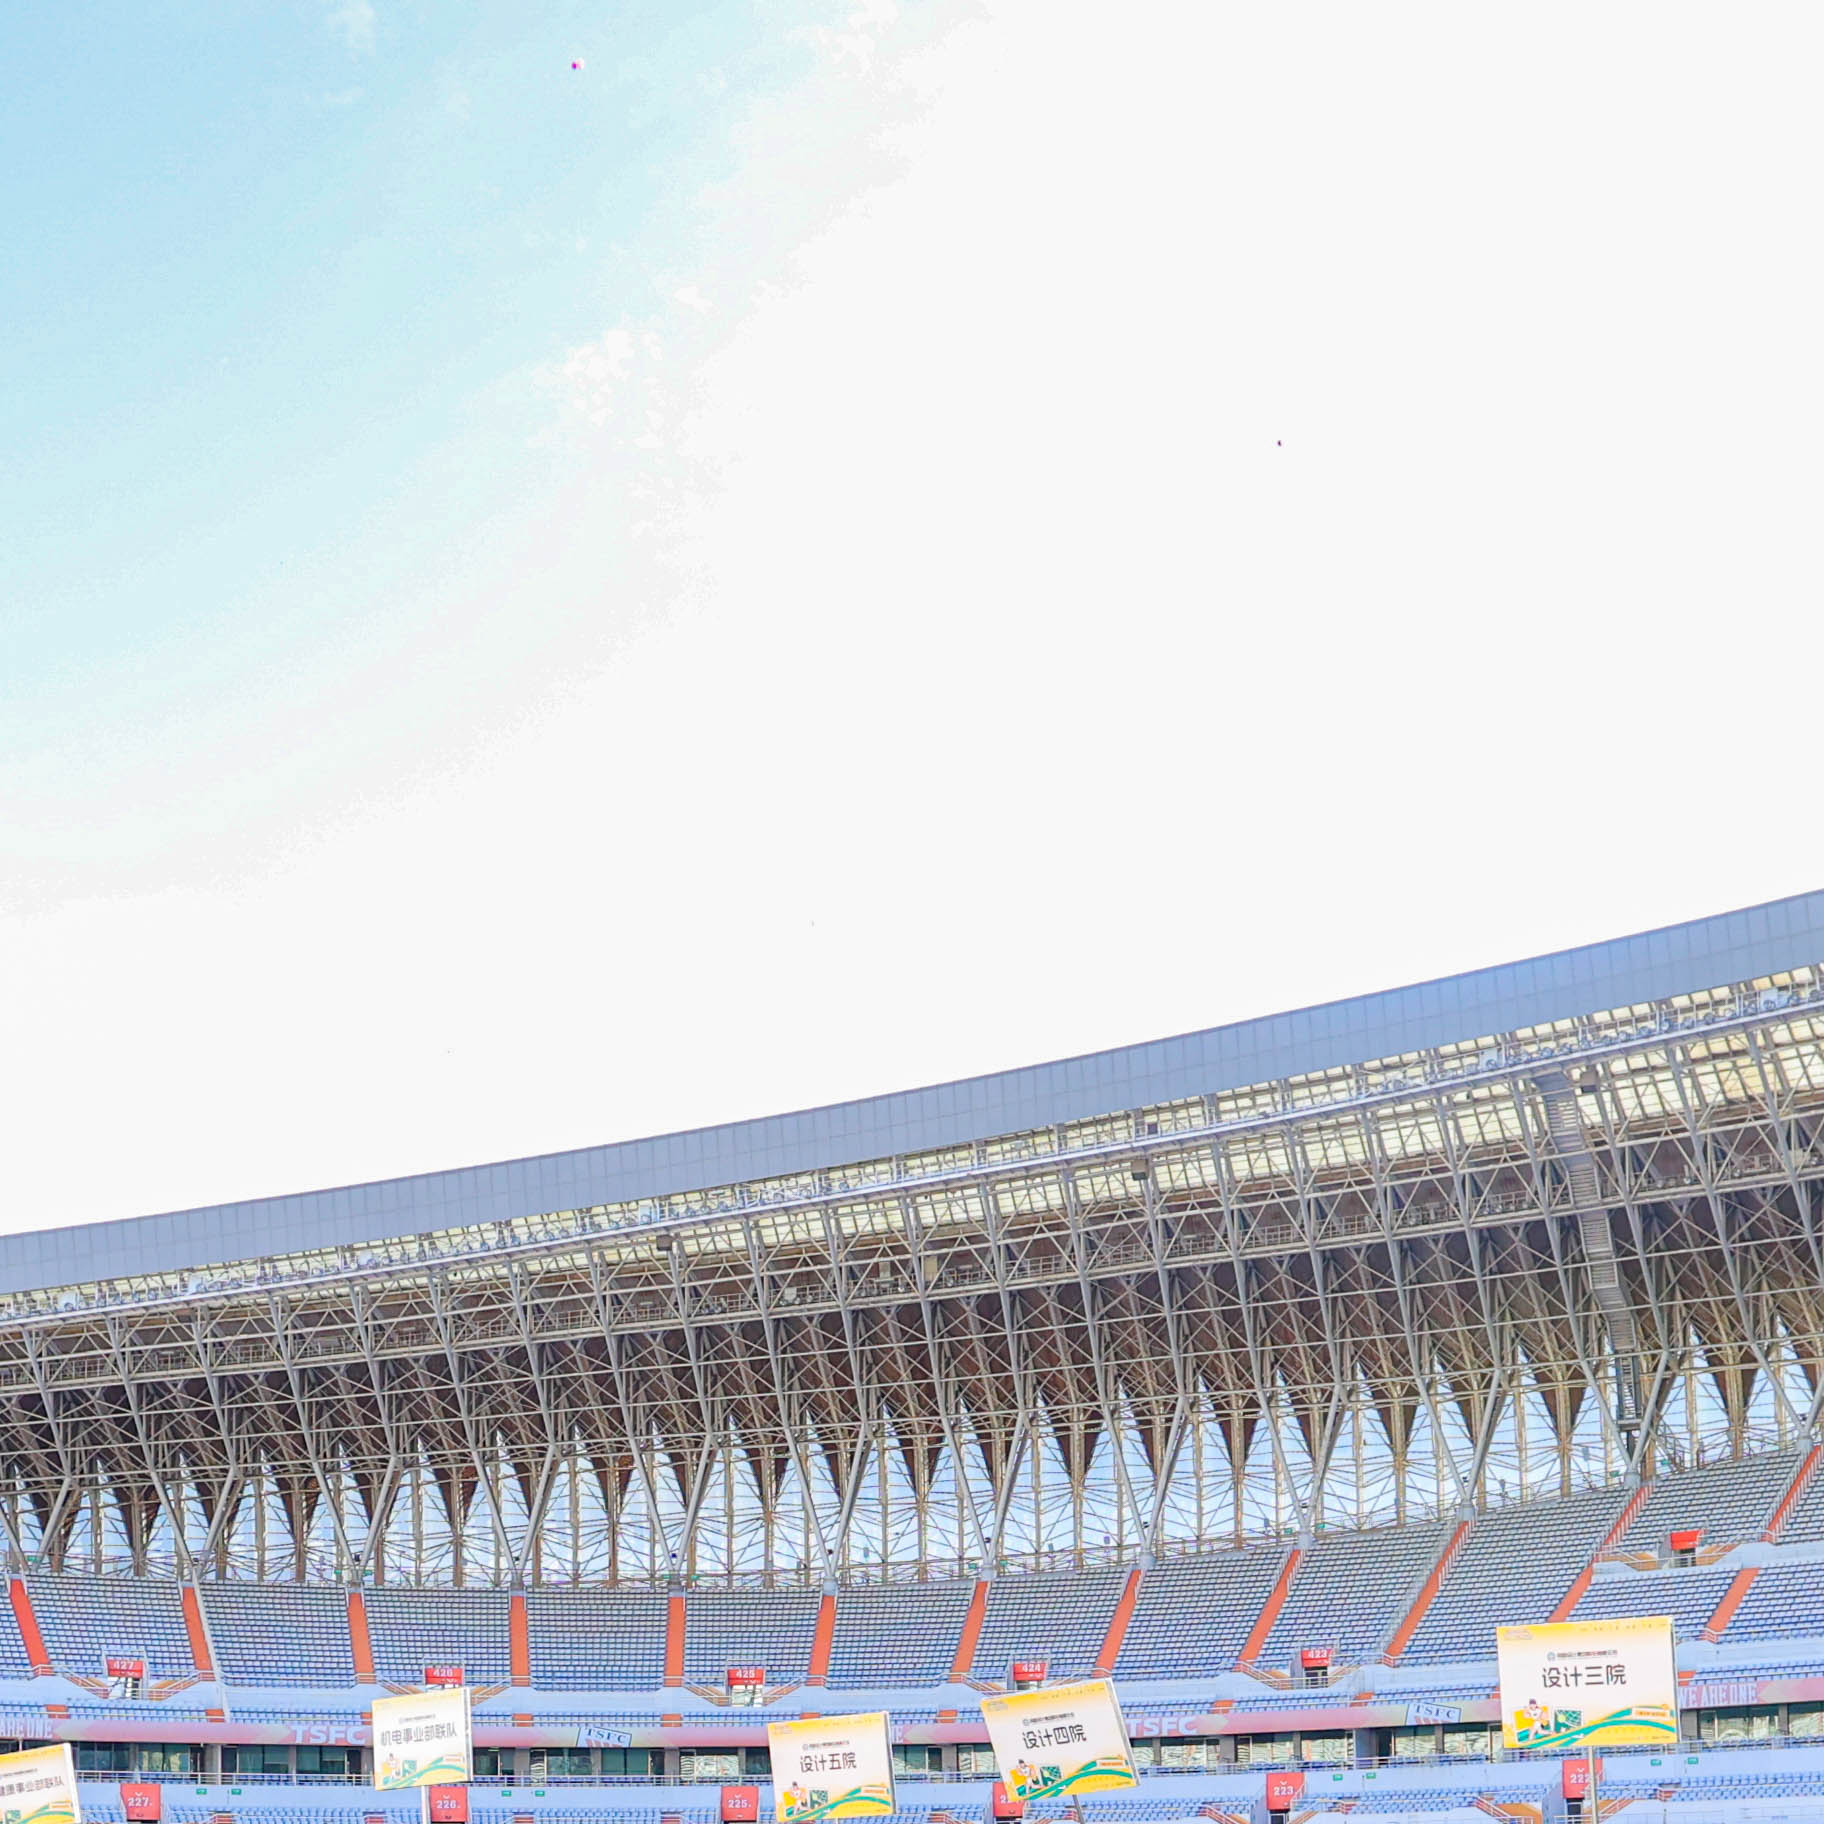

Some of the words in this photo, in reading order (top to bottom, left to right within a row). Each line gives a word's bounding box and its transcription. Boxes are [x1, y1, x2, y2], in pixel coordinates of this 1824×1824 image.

[1308, 1650, 1327, 1658] 423
[113, 1660, 133, 1670] 427
[1022, 1662, 1041, 1672] 424
[1542, 1664, 1627, 1688] 设计三院
[1699, 1684, 1728, 1707] ARE
[1730, 1682, 1757, 1706] ONE
[1414, 1705, 1454, 1719] TSFC
[27, 1720, 53, 1739] ONE
[292, 1725, 366, 1745] TSFC
[381, 1722, 457, 1746] 机电事业部联队
[586, 1728, 625, 1743] TSFC
[1022, 1724, 1087, 1749] 设计四院
[1127, 1717, 1198, 1737] TSFC
[800, 1752, 857, 1773] 设计五院
[1273, 1786, 1294, 1796] 223
[127, 1797, 149, 1807] 227
